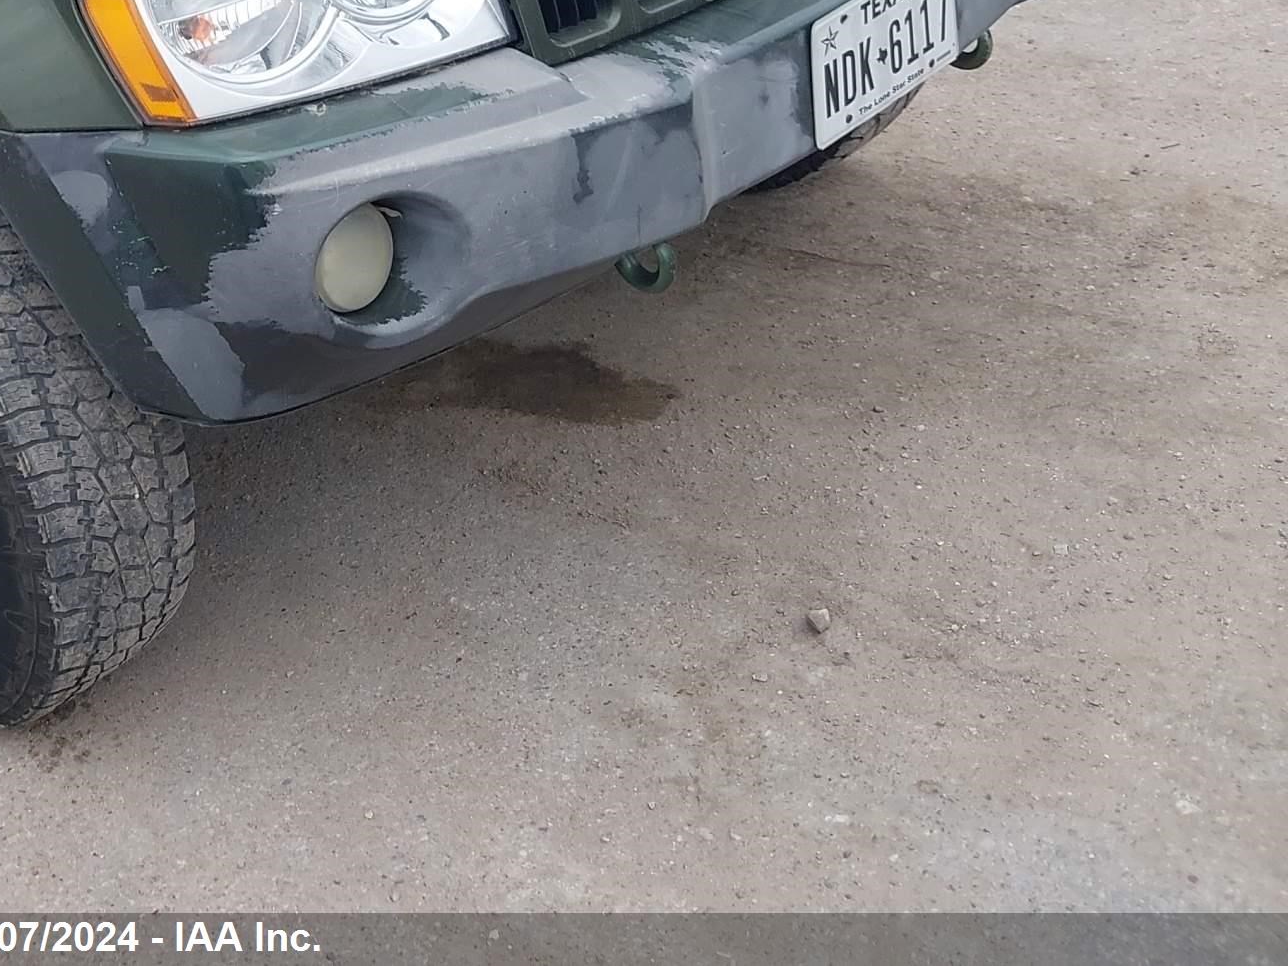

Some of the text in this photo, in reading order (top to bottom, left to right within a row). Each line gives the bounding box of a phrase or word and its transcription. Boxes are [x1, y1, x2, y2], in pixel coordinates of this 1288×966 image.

[824, 37, 875, 118] NDK
[859, 68, 925, 115] The Lone Star State
